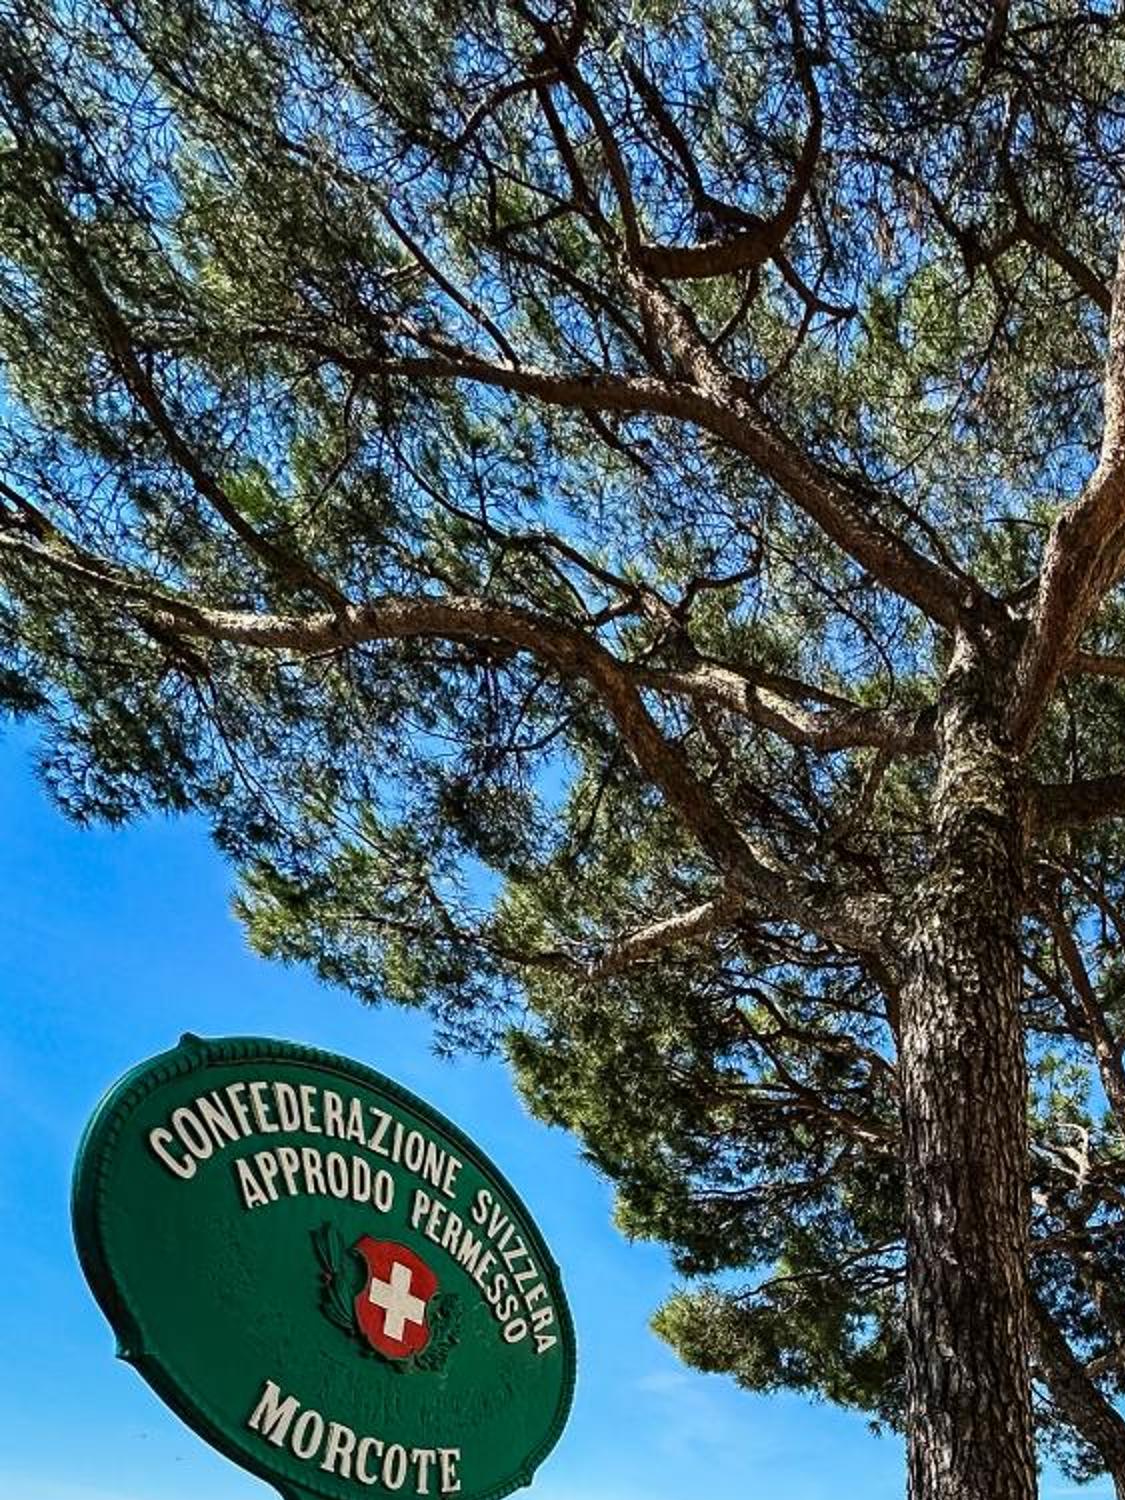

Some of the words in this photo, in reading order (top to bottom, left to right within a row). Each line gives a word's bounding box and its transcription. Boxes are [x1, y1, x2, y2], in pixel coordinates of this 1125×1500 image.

[149, 1080, 463, 1198] CONFEDERAZIONE
[471, 1189, 558, 1354] SVIZZERA
[235, 1147, 395, 1212] APPRODO
[411, 1190, 529, 1344] PERMESSO
[248, 1380, 462, 1495] MORCOTE
